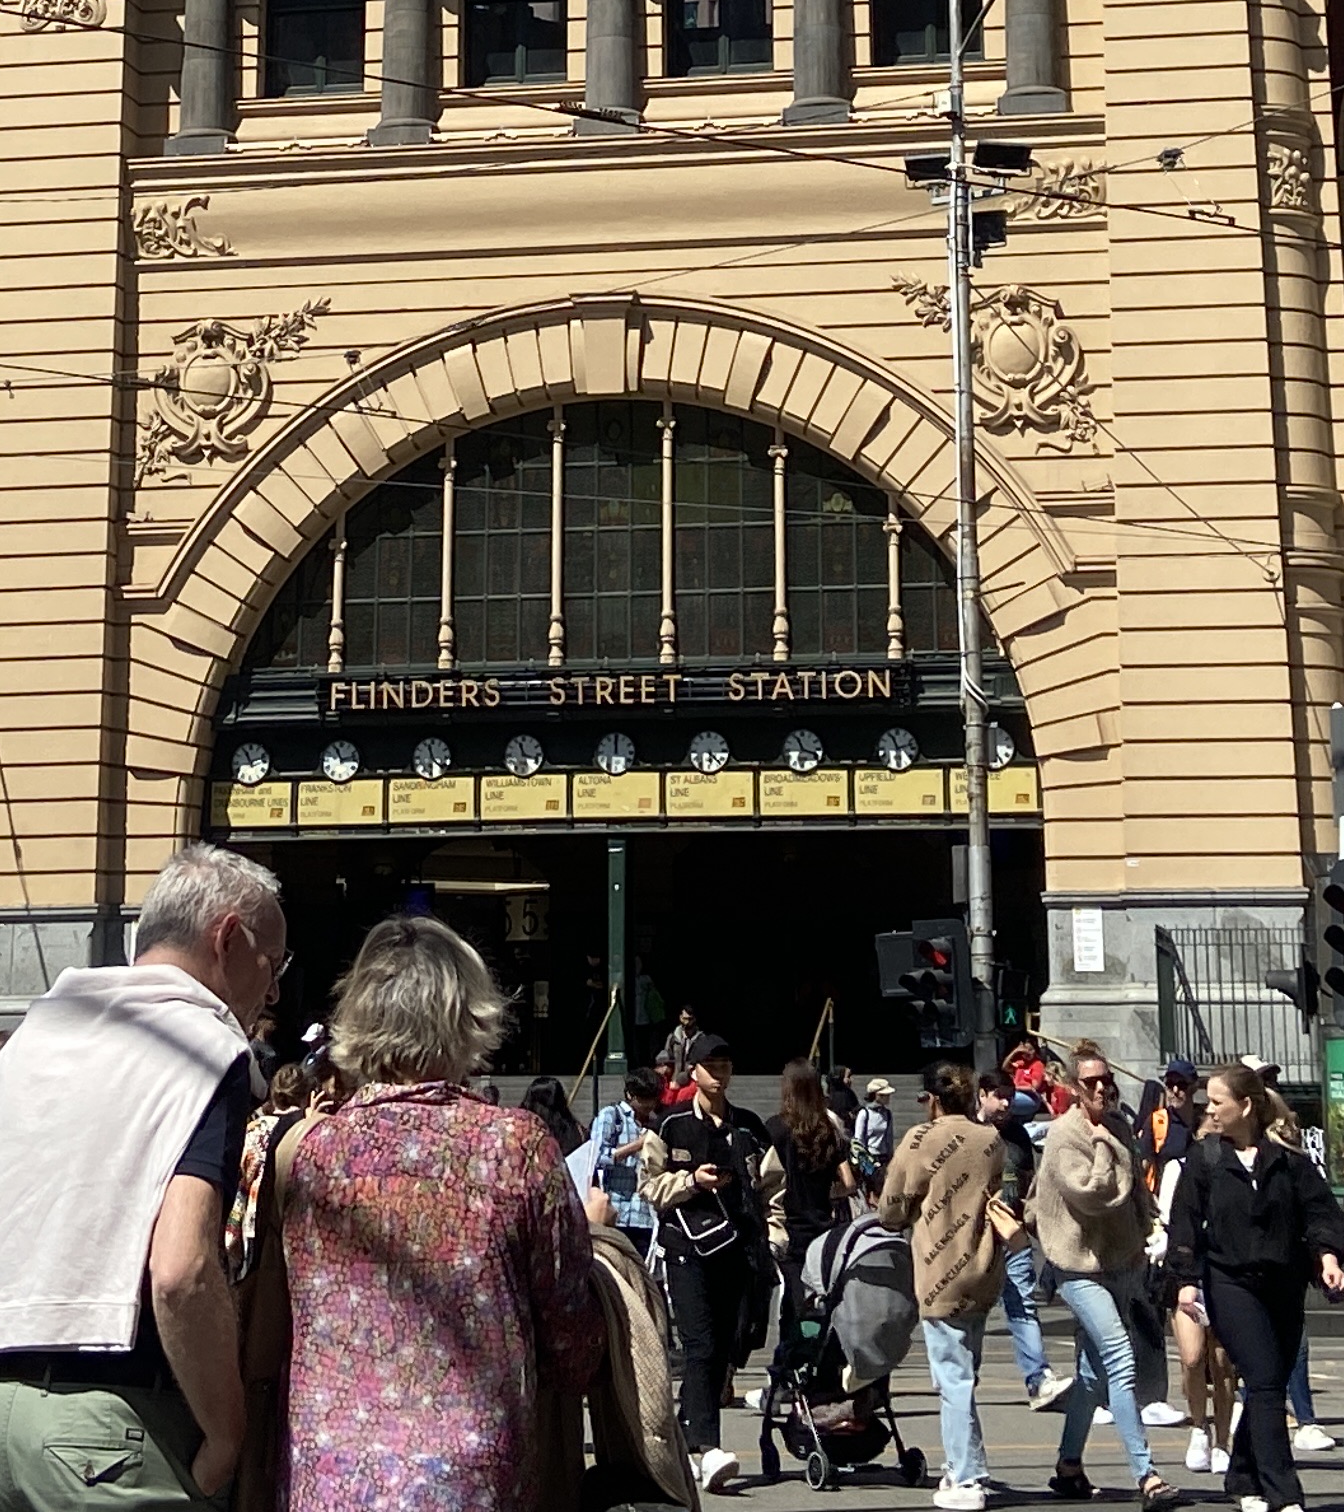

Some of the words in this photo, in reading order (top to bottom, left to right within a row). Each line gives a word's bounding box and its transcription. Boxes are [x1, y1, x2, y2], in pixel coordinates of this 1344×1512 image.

[330, 677, 501, 711] FLINDERS
[549, 673, 682, 706] STREET
[727, 669, 892, 701] STATION
[485, 777, 553, 789] WILLIAMSTOWN
[578, 774, 612, 785] ALTONA
[670, 775, 681, 785] ST
[683, 774, 718, 785] ALBANS
[300, 782, 353, 794] FRANKSTON
[392, 779, 457, 792] SANDRINGHAM
[484, 791, 505, 801] LINE
[577, 788, 597, 798] LINE
[669, 787, 690, 798] LINE
[764, 786, 784, 797] LINE
[300, 797, 319, 807] LINE
[392, 793, 412, 804] LINE
